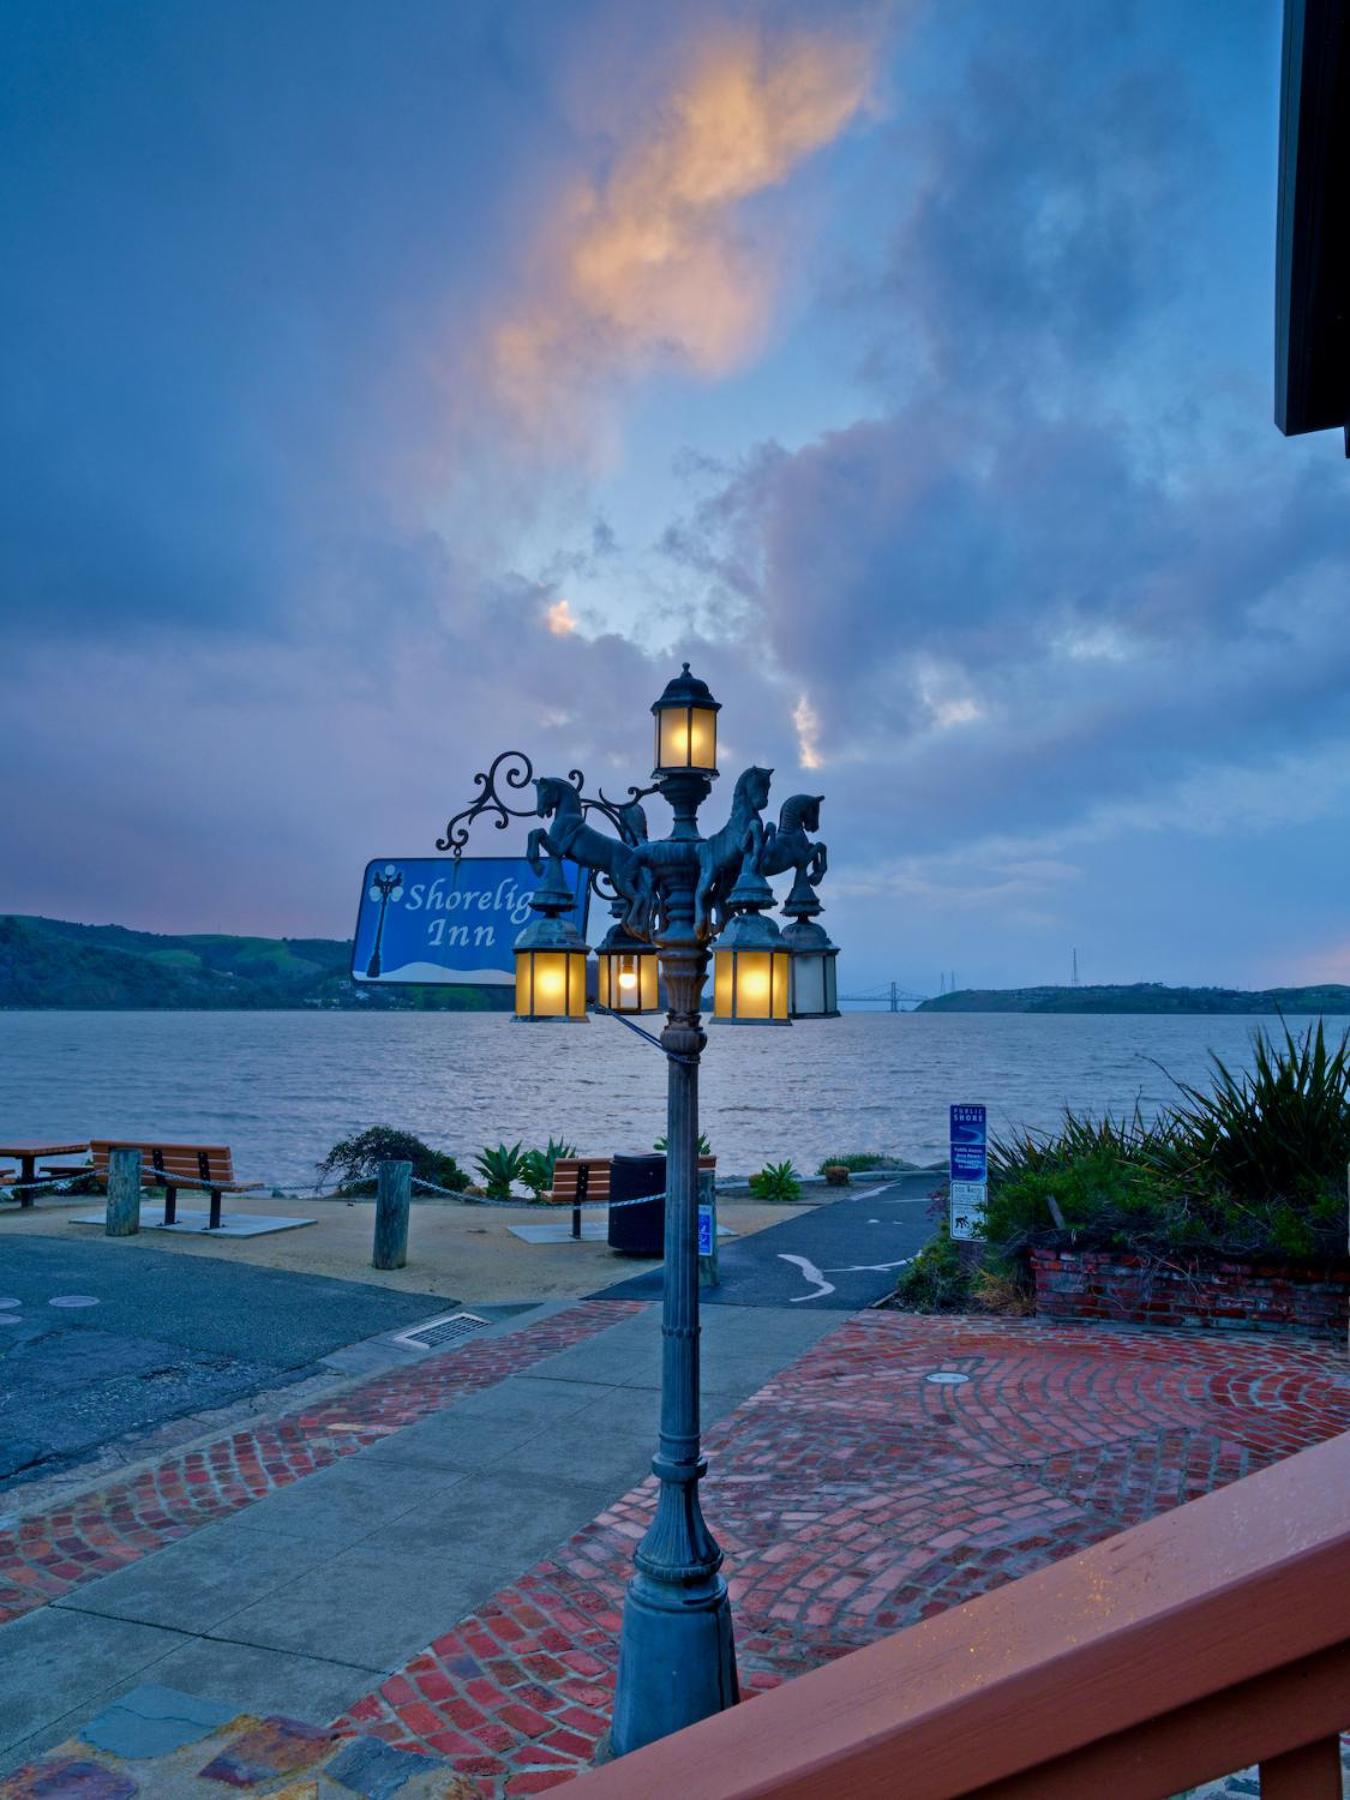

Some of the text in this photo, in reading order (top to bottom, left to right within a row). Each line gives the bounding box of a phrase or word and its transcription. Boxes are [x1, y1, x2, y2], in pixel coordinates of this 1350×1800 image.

[405, 879, 535, 925] Shorelig
[428, 919, 496, 946] Inn
[953, 1114, 983, 1122] SHORE
